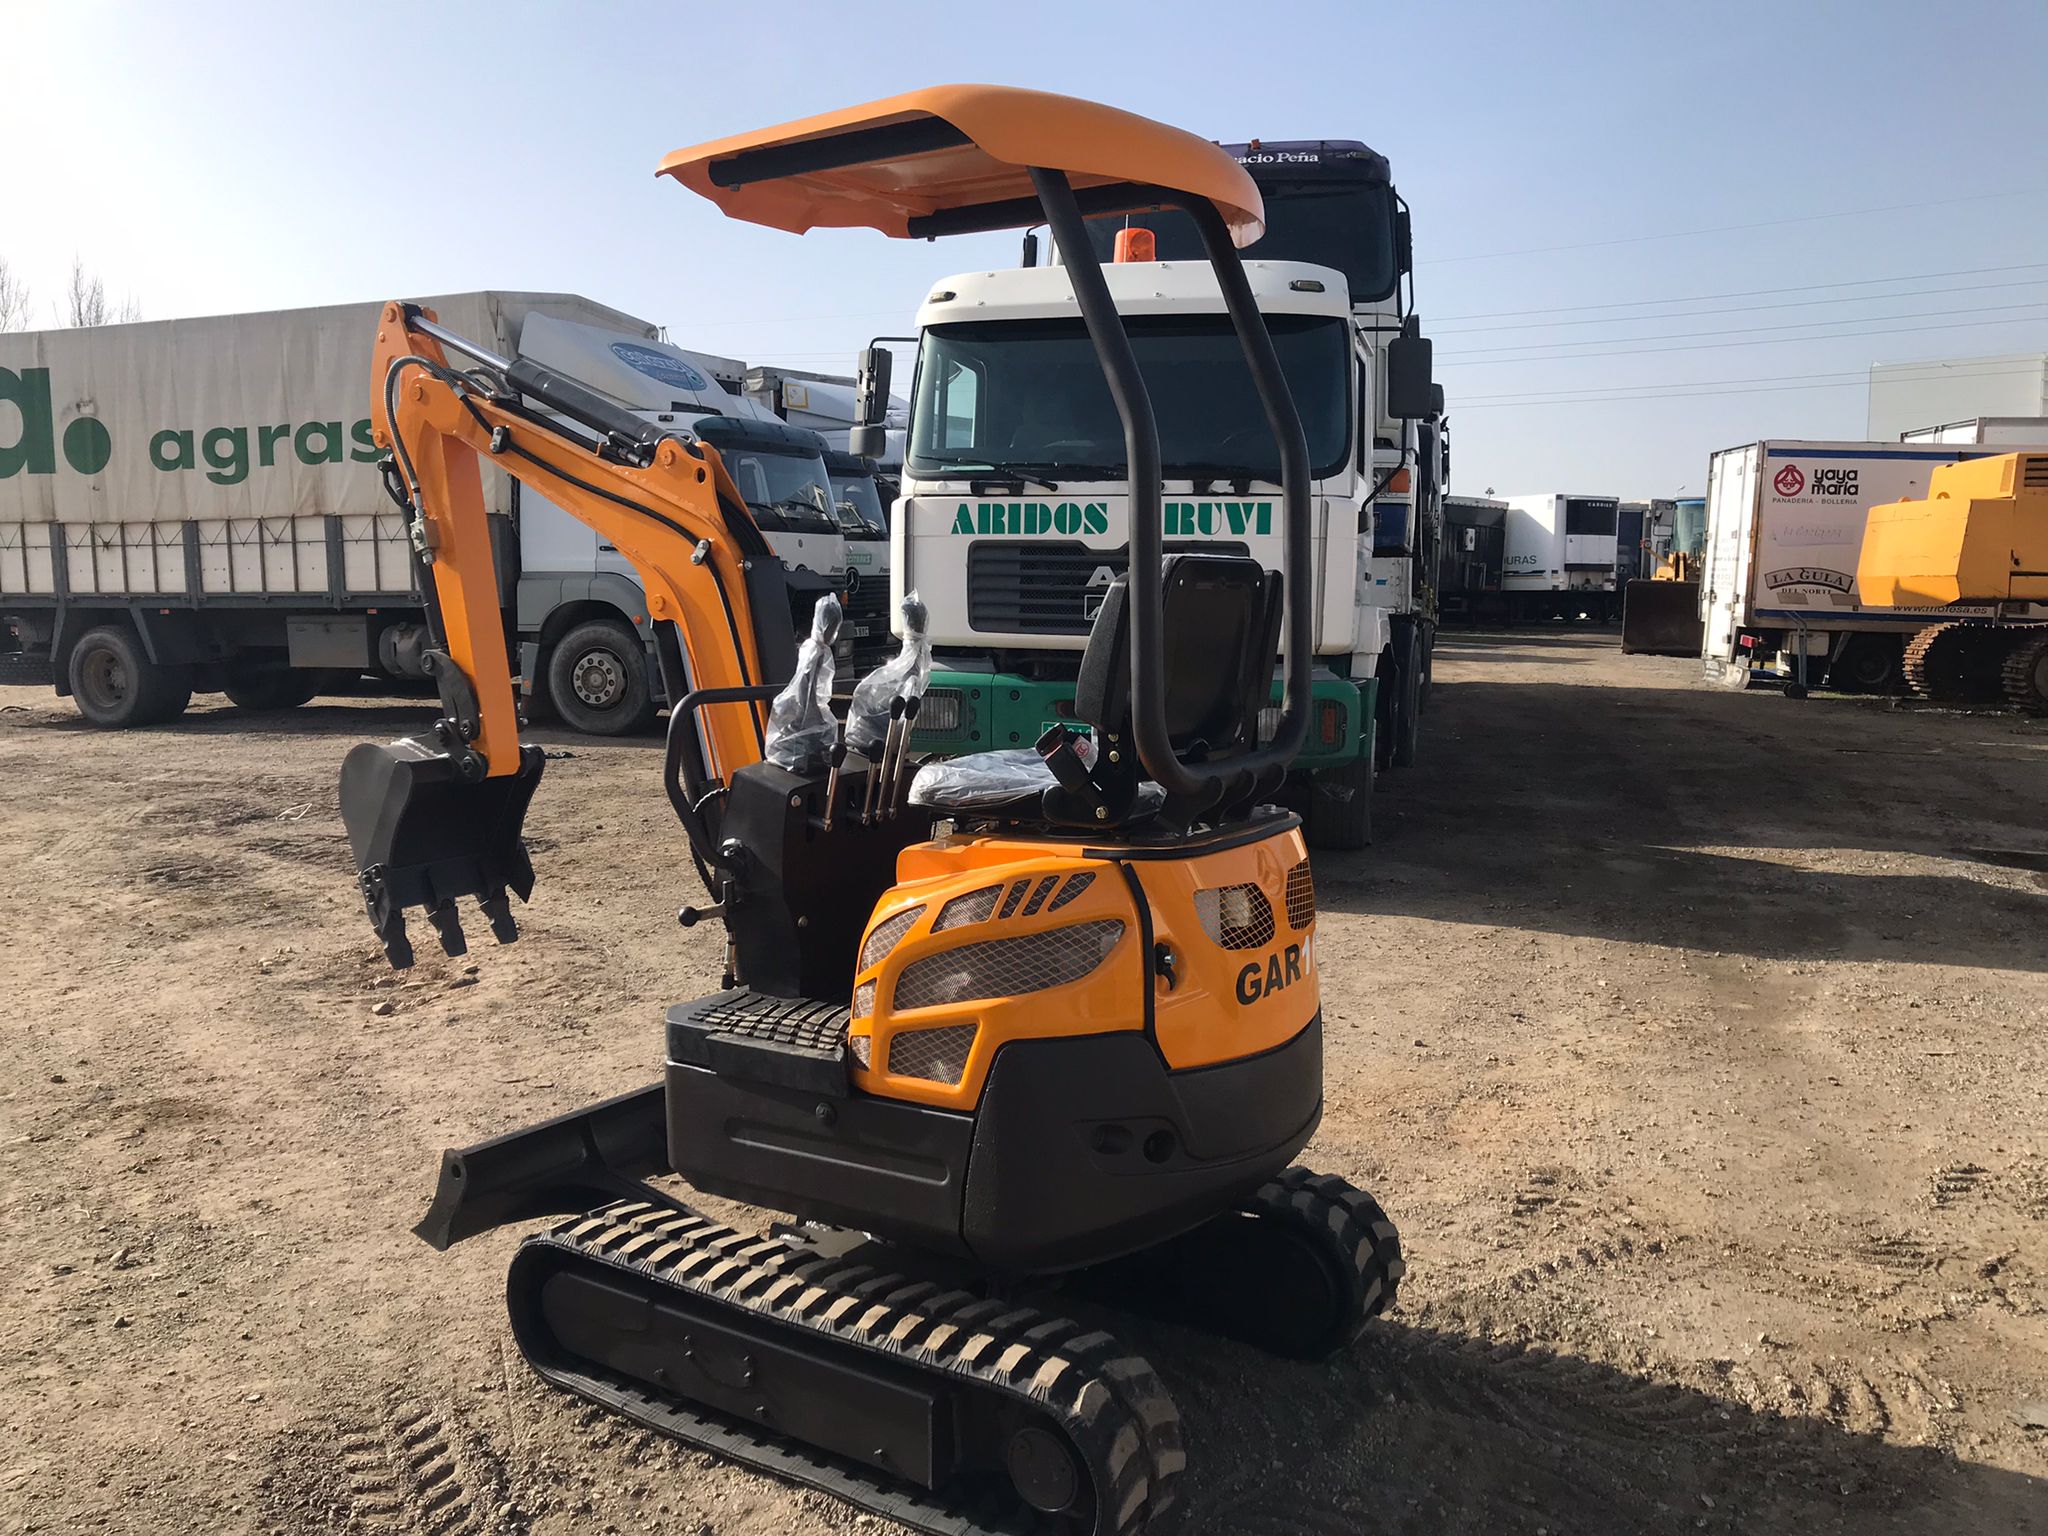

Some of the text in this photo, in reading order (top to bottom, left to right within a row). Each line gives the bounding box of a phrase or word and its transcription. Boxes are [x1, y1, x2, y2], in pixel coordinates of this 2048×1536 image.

[1234, 152, 1319, 164] acio Peña
[1814, 469, 1858, 484] yaya
[951, 503, 1272, 535] ARIDOS RUVI
[1503, 555, 1537, 565] URAS
[1772, 568, 1844, 586] LA GULA
[1235, 931, 1317, 1006] GAR1
